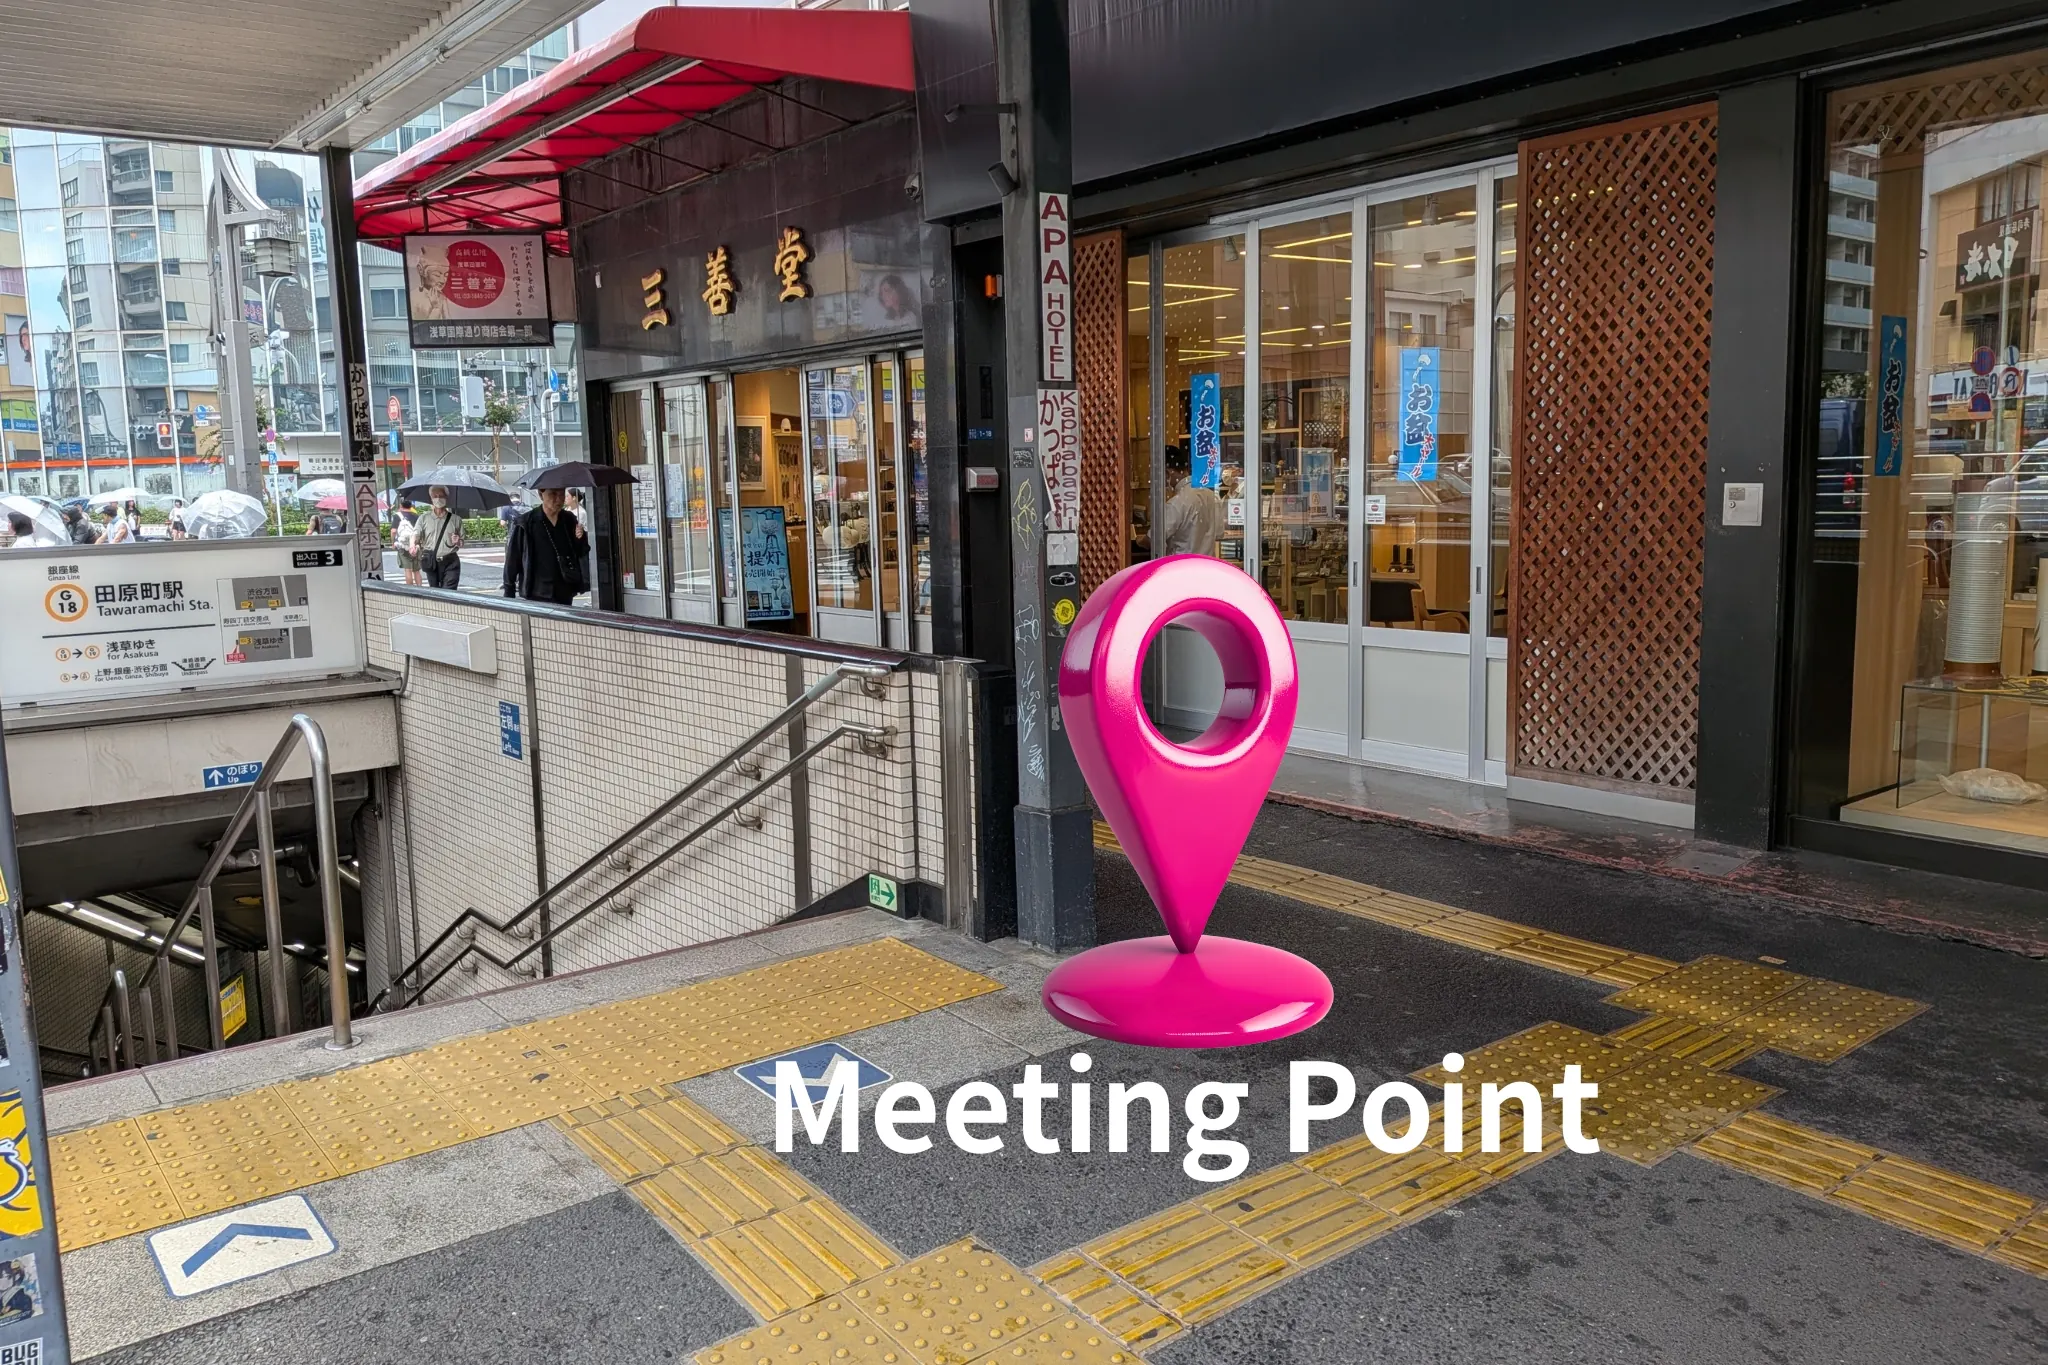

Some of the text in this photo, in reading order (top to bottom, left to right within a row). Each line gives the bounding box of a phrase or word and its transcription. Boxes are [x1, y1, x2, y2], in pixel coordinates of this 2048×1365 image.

[1041, 195, 1069, 285] APA
[450, 277, 497, 290] 三善堂
[641, 226, 810, 331] 三善堂
[1046, 293, 1066, 380] HOTEL
[1881, 358, 1902, 432] お盆
[1406, 383, 1433, 446] お盆
[1195, 404, 1216, 458] お盆
[1060, 391, 1078, 531] Kappabashi
[296, 551, 335, 565] 出入口 3
[47, 565, 80, 575] 銀座線
[60, 590, 72, 601] G
[94, 581, 185, 604] 田原町駅
[58, 602, 77, 614] 18
[96, 599, 214, 617] Tawaramachi Sta.
[106, 639, 156, 653] 浅草ゆき
[107, 651, 159, 661] for Asakusa
[145, 671, 169, 679] Shibuya
[226, 764, 258, 776] のぼり
[227, 776, 240, 784] Up
